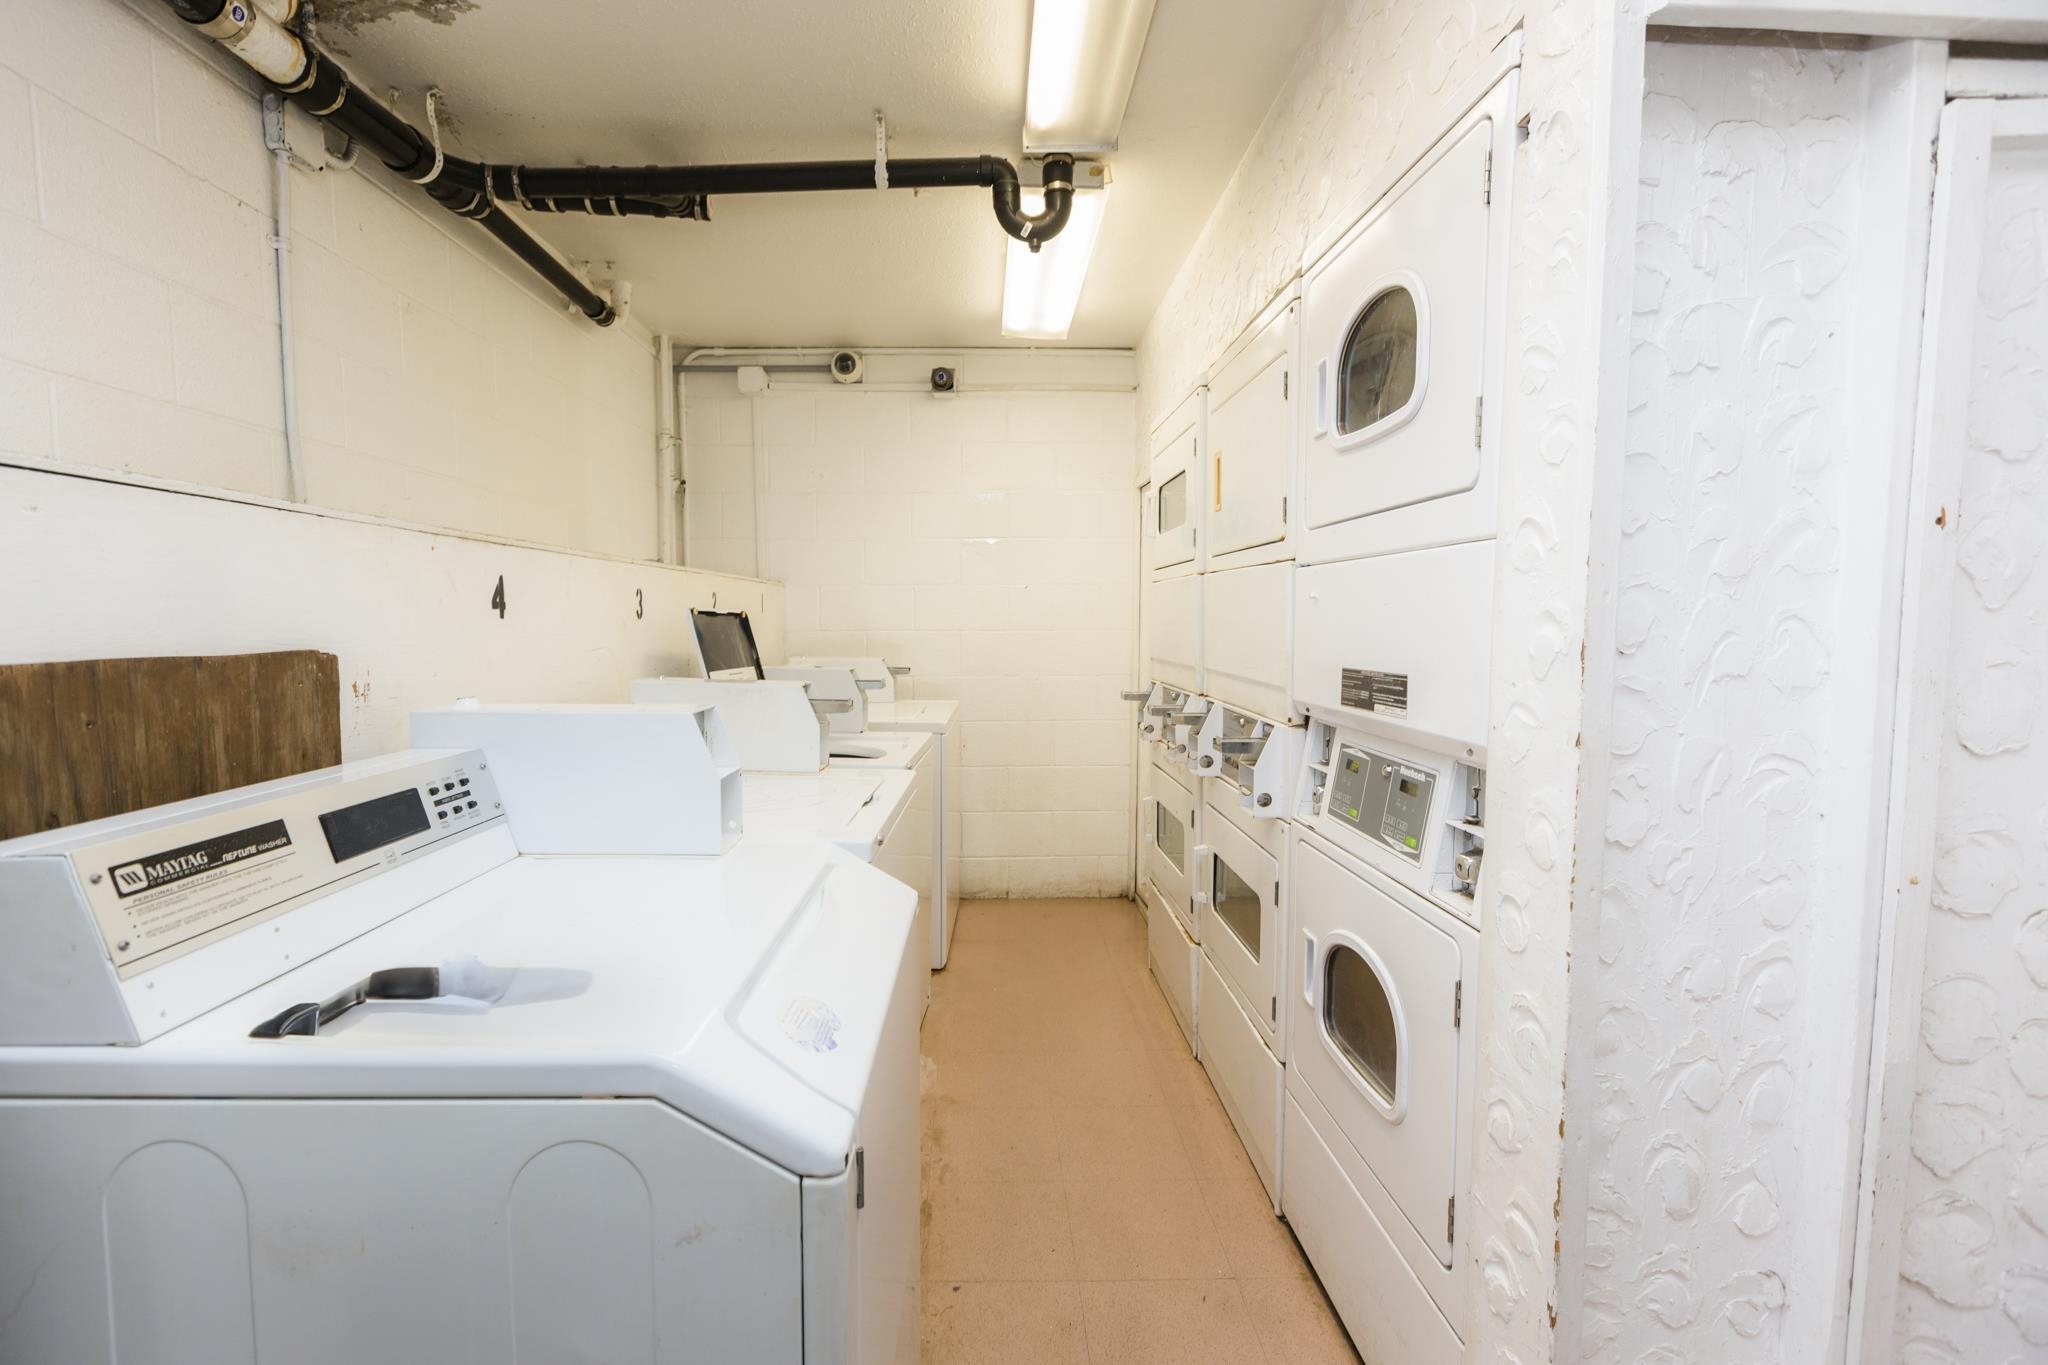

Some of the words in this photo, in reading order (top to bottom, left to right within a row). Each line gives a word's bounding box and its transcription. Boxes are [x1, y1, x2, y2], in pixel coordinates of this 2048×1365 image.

[491, 574, 506, 619] 4
[635, 588, 643, 620] 3
[145, 850, 208, 879] MAYTAG
[150, 864, 210, 887] COMMERCIAL
[222, 844, 257, 863] NEPTUNE
[257, 837, 287, 851] WASHER
